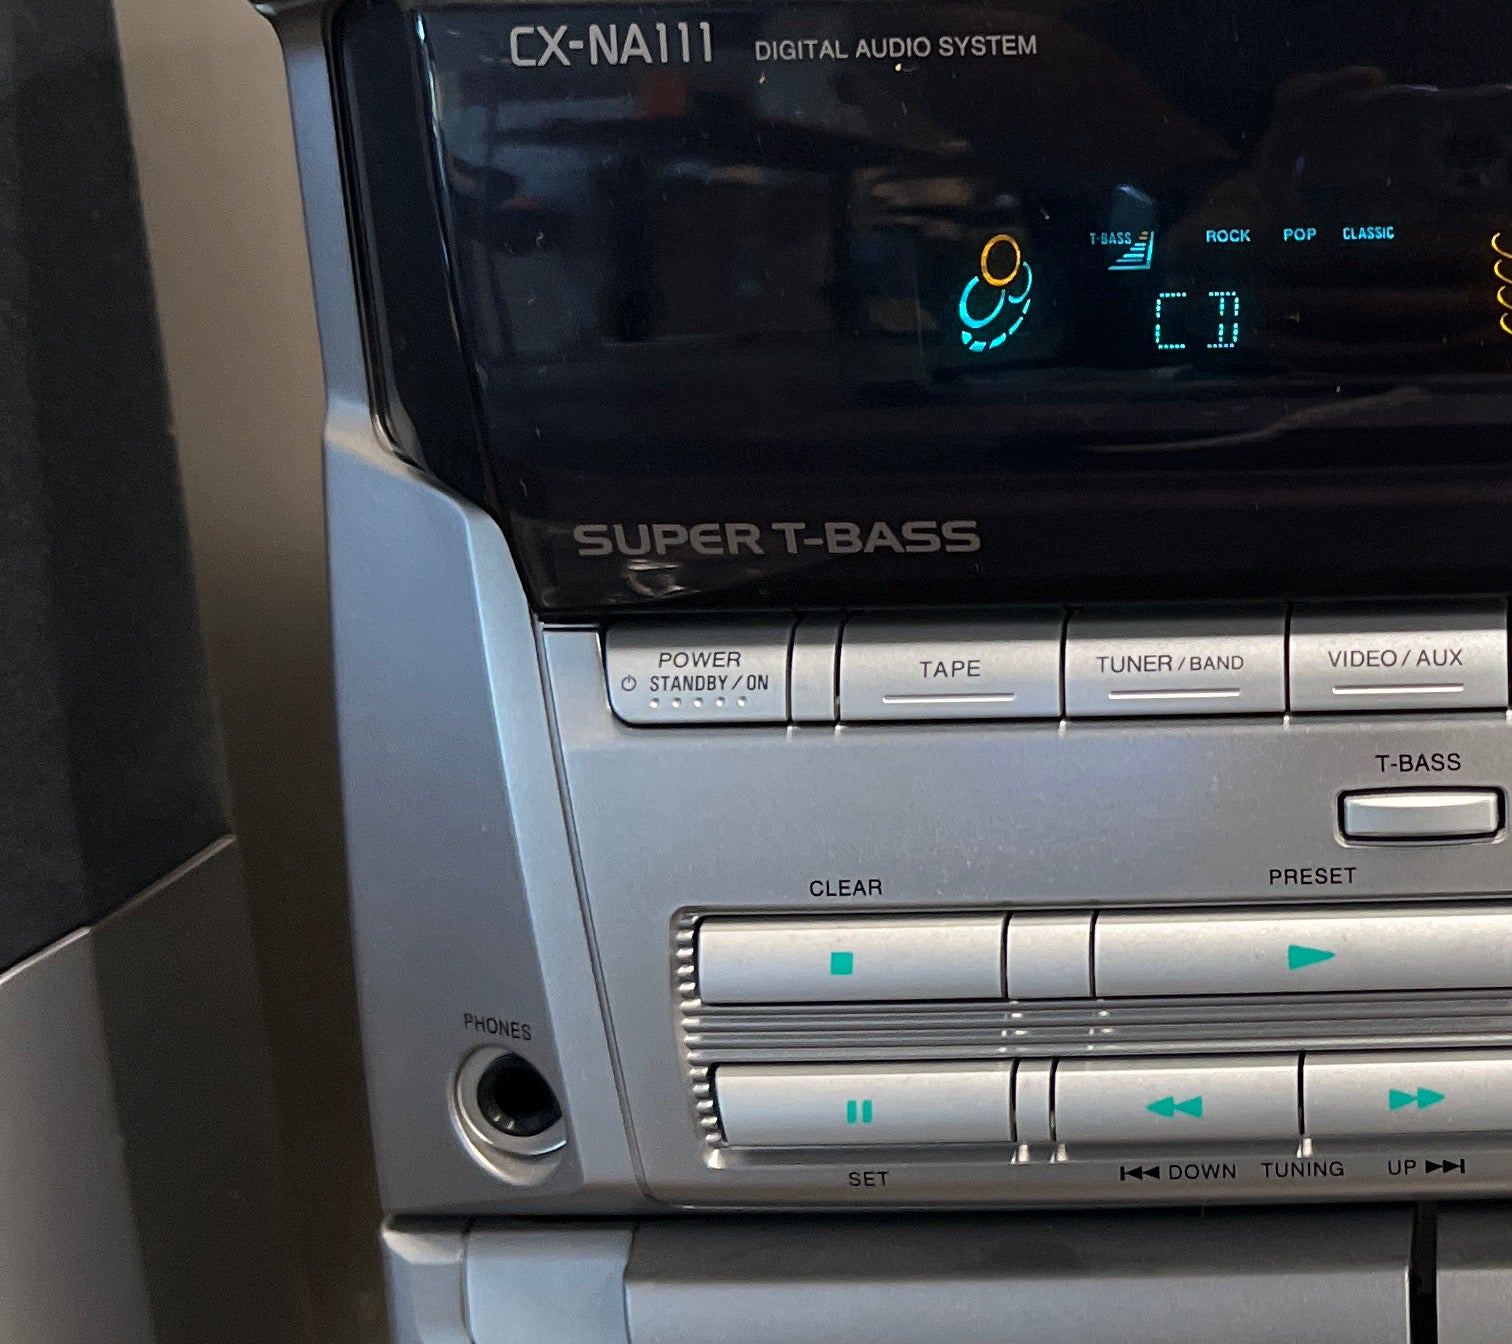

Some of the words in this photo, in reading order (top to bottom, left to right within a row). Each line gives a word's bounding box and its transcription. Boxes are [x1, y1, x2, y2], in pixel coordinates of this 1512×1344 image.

[508, 21, 714, 68] CX-NA111
[753, 40, 849, 61] DIGITAL
[855, 37, 932, 59] AUDIO
[937, 34, 1039, 57] SYSTEM
[1205, 228, 1251, 243] ROCK
[1282, 227, 1318, 242] POP
[1342, 225, 1395, 241] CLASSIC
[573, 522, 765, 557] SUPER
[771, 518, 982, 555] T-BASS
[658, 650, 742, 668] POWER
[918, 659, 982, 679] TAPE
[1374, 752, 1462, 773] T-BASS
[1267, 866, 1358, 886] PRESET
[808, 877, 884, 898] CLEAR
[462, 1011, 533, 1043] PHONES
[847, 1169, 890, 1189] SET
[1167, 1163, 1237, 1181] DOWN
[1260, 1160, 1345, 1178] TUNING
[1386, 1158, 1418, 1176] UP
